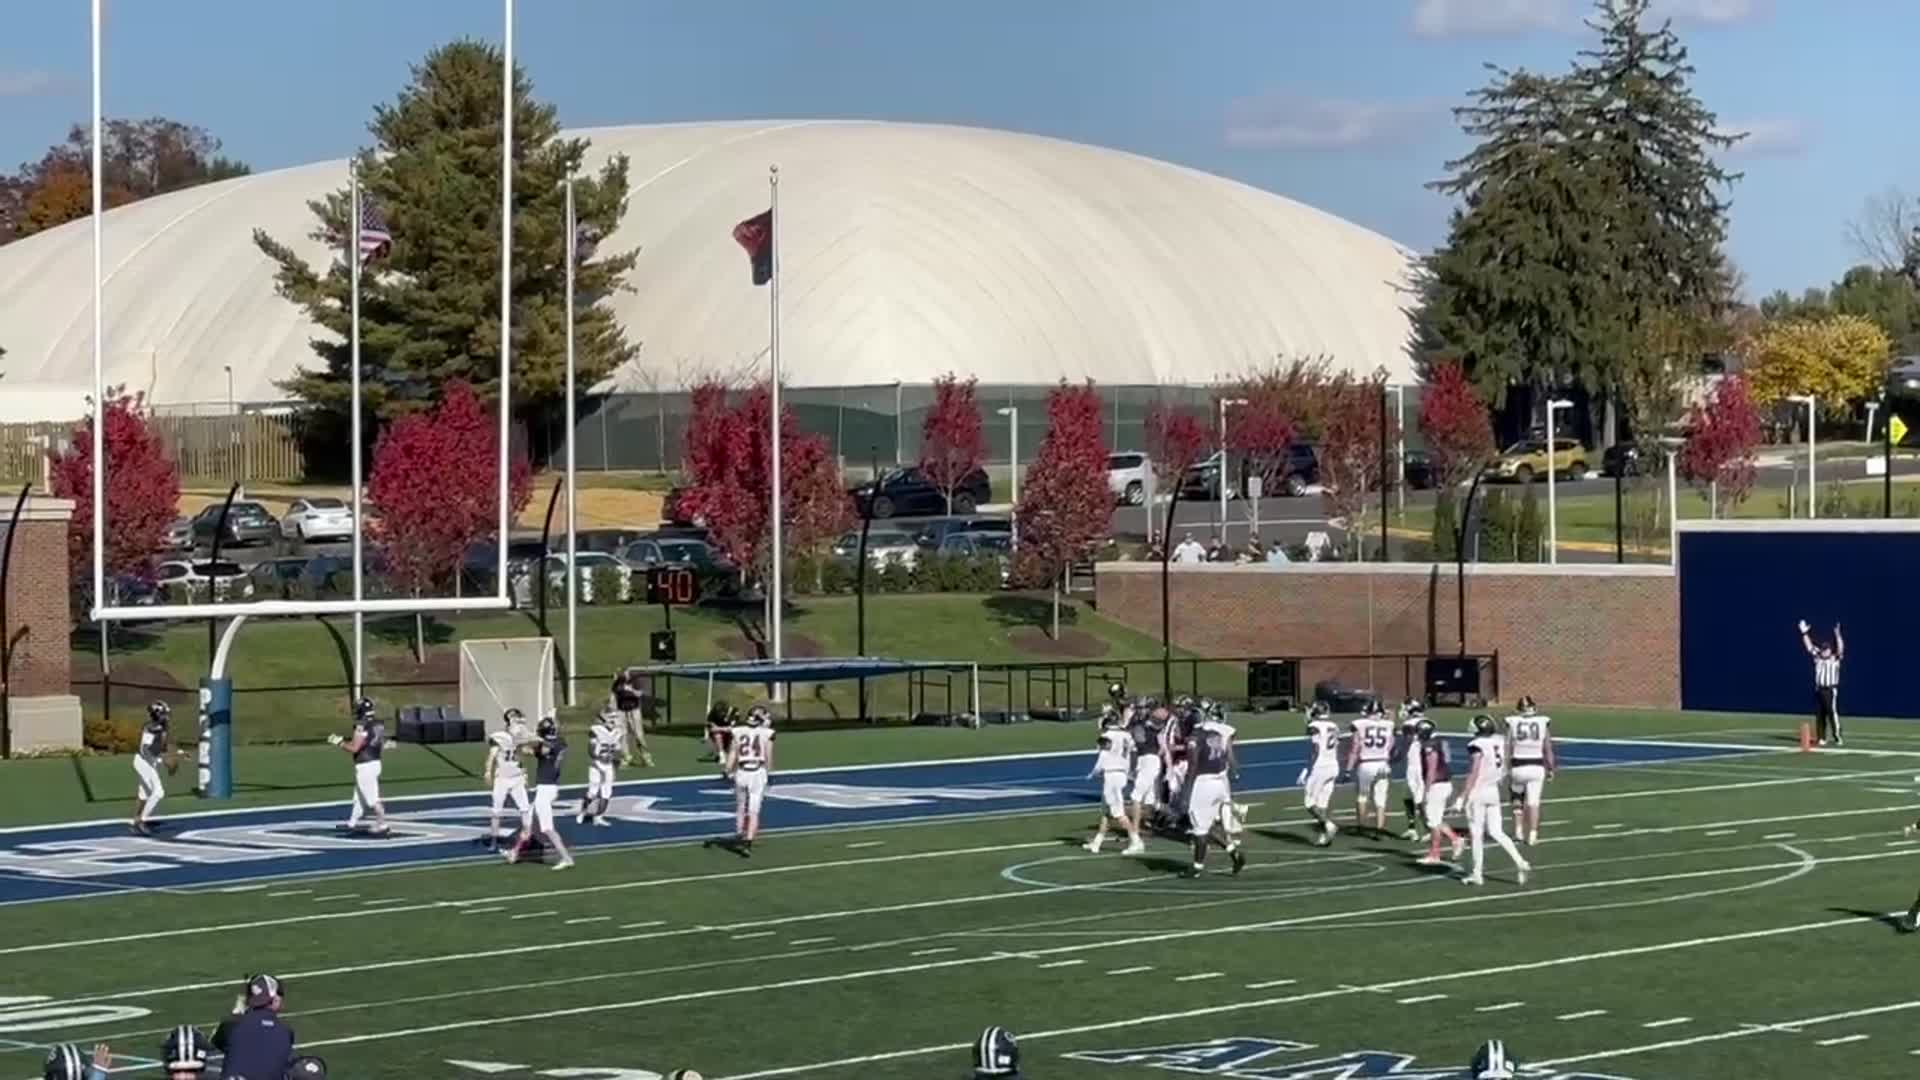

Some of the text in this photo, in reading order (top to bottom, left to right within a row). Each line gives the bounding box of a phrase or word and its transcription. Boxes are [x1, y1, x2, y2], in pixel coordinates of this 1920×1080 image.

[657, 571, 693, 602] 40
[739, 734, 761, 757] 24
[1363, 725, 1387, 748] 55
